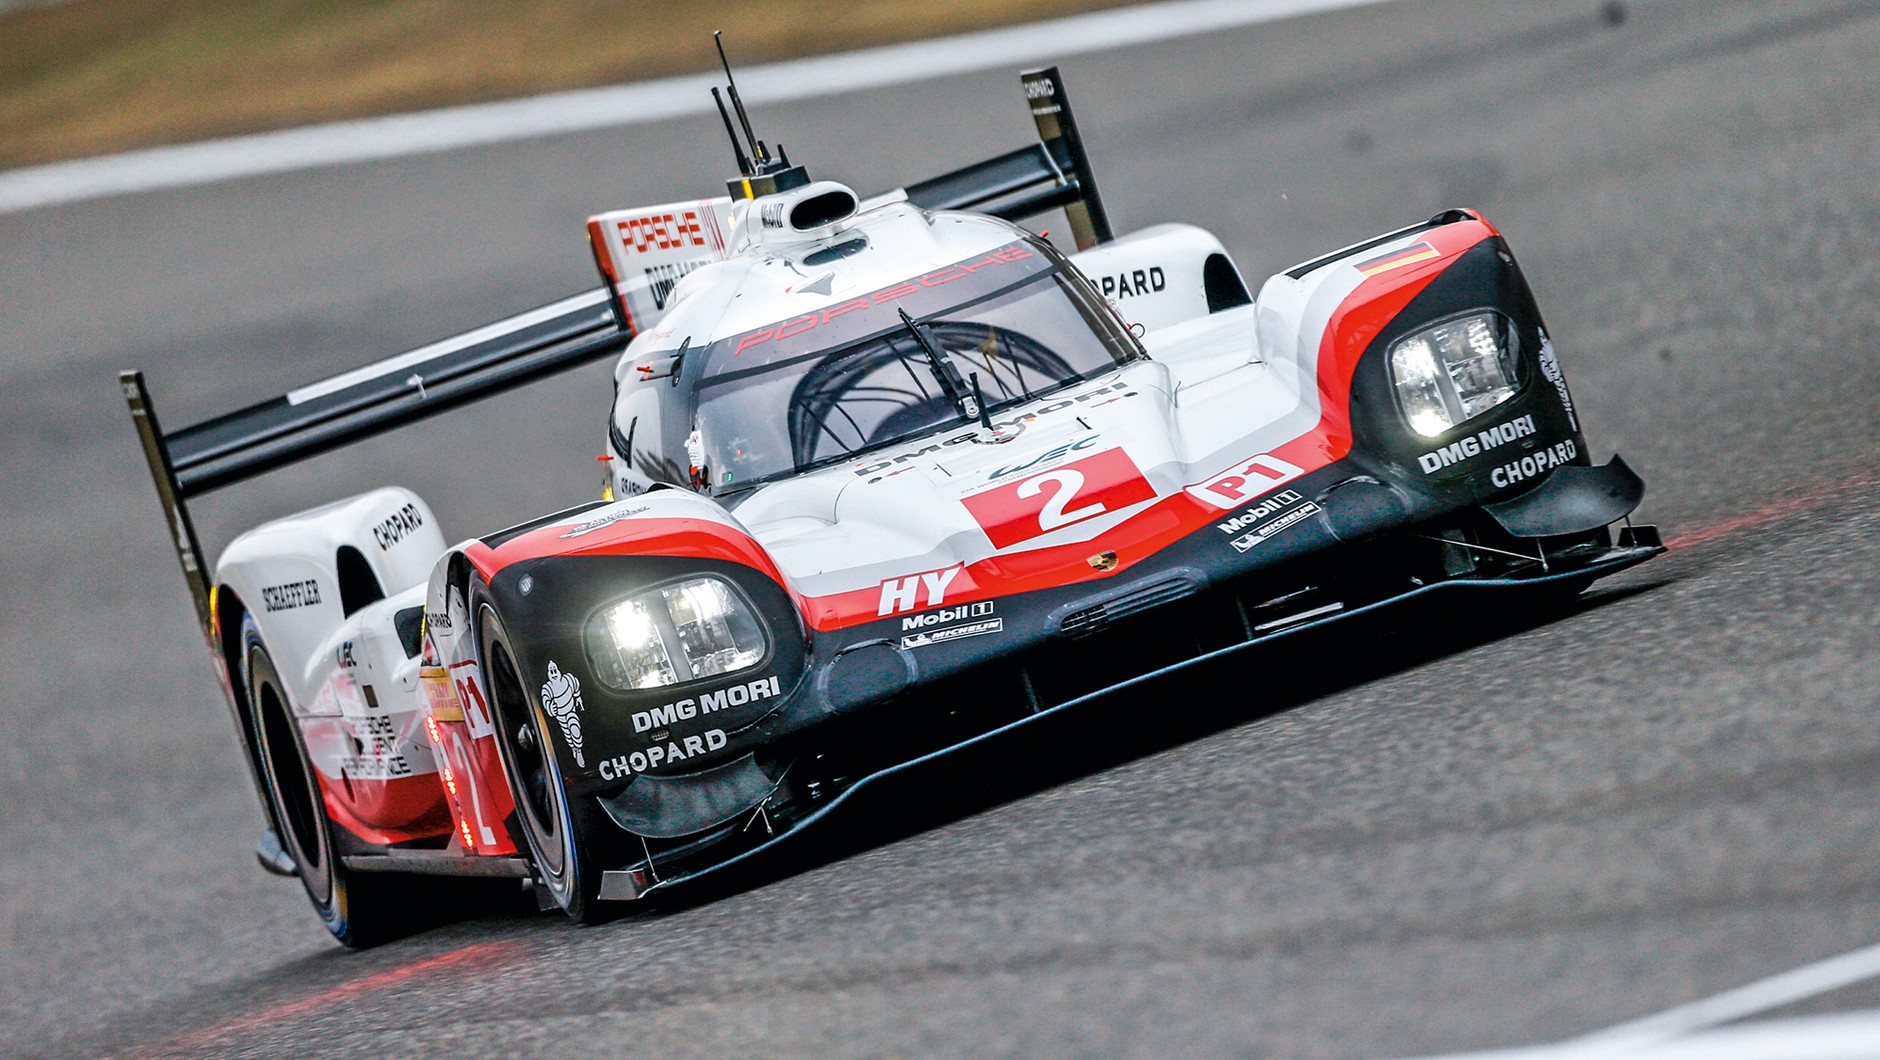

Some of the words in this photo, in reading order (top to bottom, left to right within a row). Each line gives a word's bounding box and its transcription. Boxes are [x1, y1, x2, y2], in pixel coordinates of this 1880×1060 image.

[617, 212, 705, 255] PORSCHE
[733, 246, 1034, 356] PORSCHE
[1090, 266, 1166, 298] PARD
[853, 432, 979, 477] DMG
[988, 382, 1129, 429] MORI
[1417, 436, 1481, 474] DMG
[1481, 414, 1537, 451] MORI
[1205, 462, 1287, 500] P1
[1490, 439, 1577, 488] CHOPARD
[1016, 469, 1107, 532] 2
[1217, 494, 1279, 534] Mobil
[1258, 503, 1315, 536] MICHELIN
[373, 503, 423, 550] CHOPARD
[262, 579, 322, 613] SCHAEFFLER
[877, 567, 962, 616] HY
[902, 607, 971, 631] Mobil
[932, 621, 1000, 638] MICHELIN
[455, 676, 491, 728] P1
[631, 699, 697, 733] DMG
[699, 676, 781, 714] MORI
[598, 728, 728, 781] CHOPARD
[453, 731, 497, 845] 2
